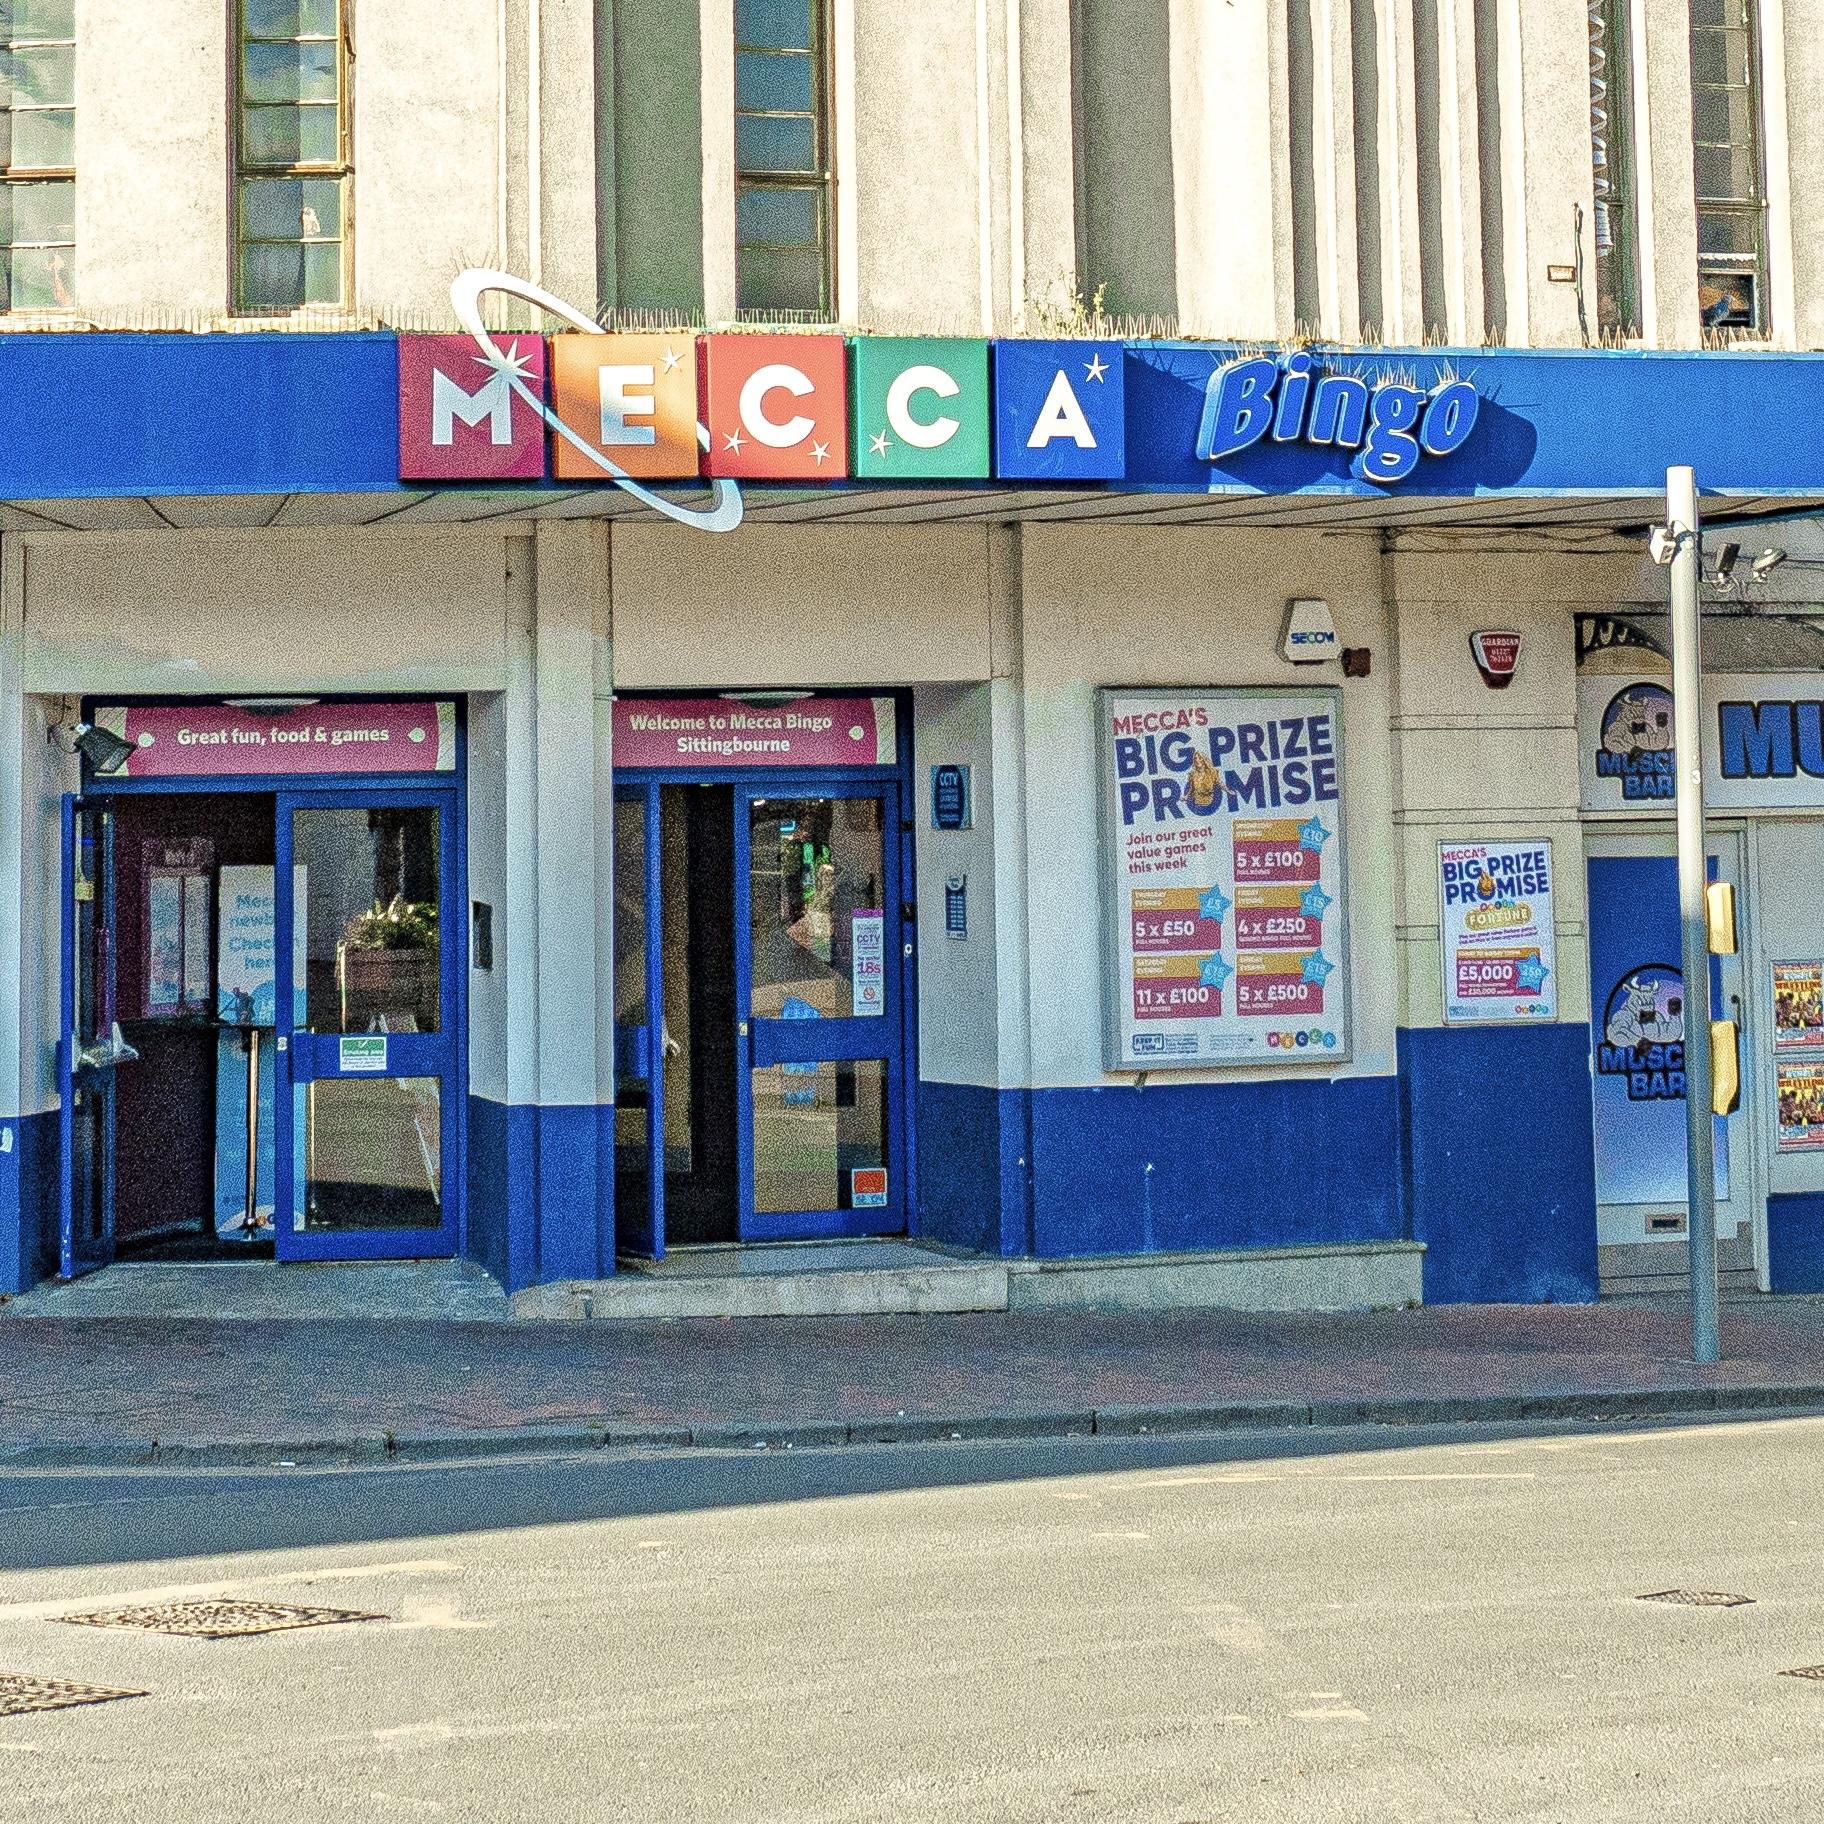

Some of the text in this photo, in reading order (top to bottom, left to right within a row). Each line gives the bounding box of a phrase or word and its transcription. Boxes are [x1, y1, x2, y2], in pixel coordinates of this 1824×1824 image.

[431, 362, 1099, 450] MECCA
[1197, 350, 1479, 482] Bingo
[1290, 630, 1335, 645] SECOM
[629, 713, 832, 733] Welcome to Mecca Bingo
[1112, 707, 1209, 736] MECCA'S
[177, 726, 389, 746] Great fun, food & games
[676, 735, 791, 756] Sittingbourne
[1115, 714, 1333, 778] BIG PRIZE
[1120, 758, 1339, 826] PROMISE
[1625, 775, 1675, 798] BAR
[1126, 826, 1213, 847] Join our great
[1127, 842, 1207, 860] value games
[1236, 850, 1304, 868] 5 x £100
[1441, 847, 1487, 862] MECCA'S
[1128, 856, 1188, 874] this week
[1443, 850, 1546, 883] BIG PRIZE
[1445, 872, 1550, 906] PROMISE
[1238, 917, 1307, 935] 4 x £250
[1468, 908, 1528, 926] FORTUNE
[1136, 919, 1195, 938] 5 x £50
[1458, 965, 1514, 984] £5,000
[1137, 986, 1210, 1005] 11 x £100
[1239, 983, 1308, 1002] 5 x £500
[1630, 1070, 1686, 1097] BAR
